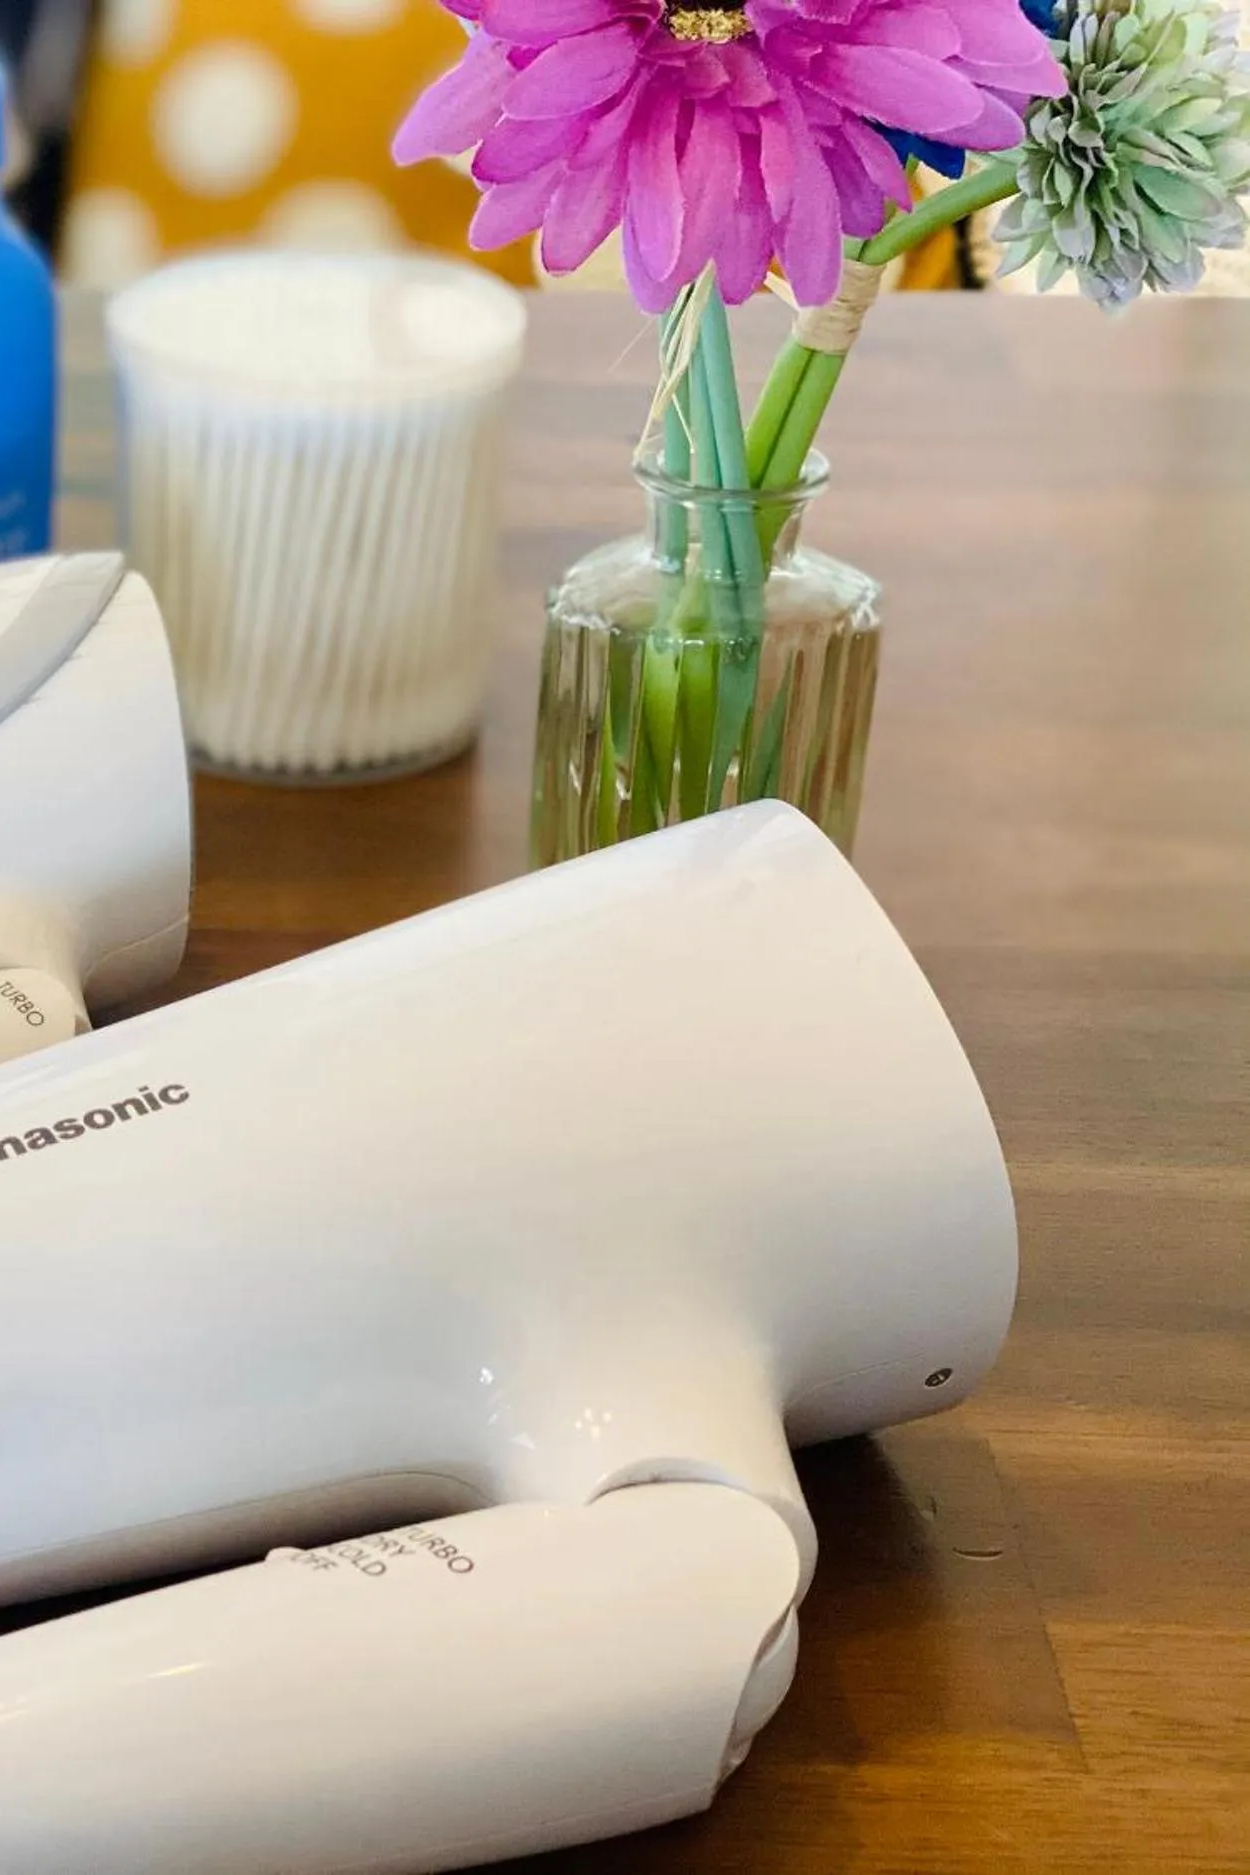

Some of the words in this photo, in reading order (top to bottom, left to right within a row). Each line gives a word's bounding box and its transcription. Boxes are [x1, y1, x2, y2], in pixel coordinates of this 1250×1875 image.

[327, 1544, 388, 1577] COLD
[361, 1534, 417, 1558] DRY
[401, 1527, 475, 1574] TURBO
